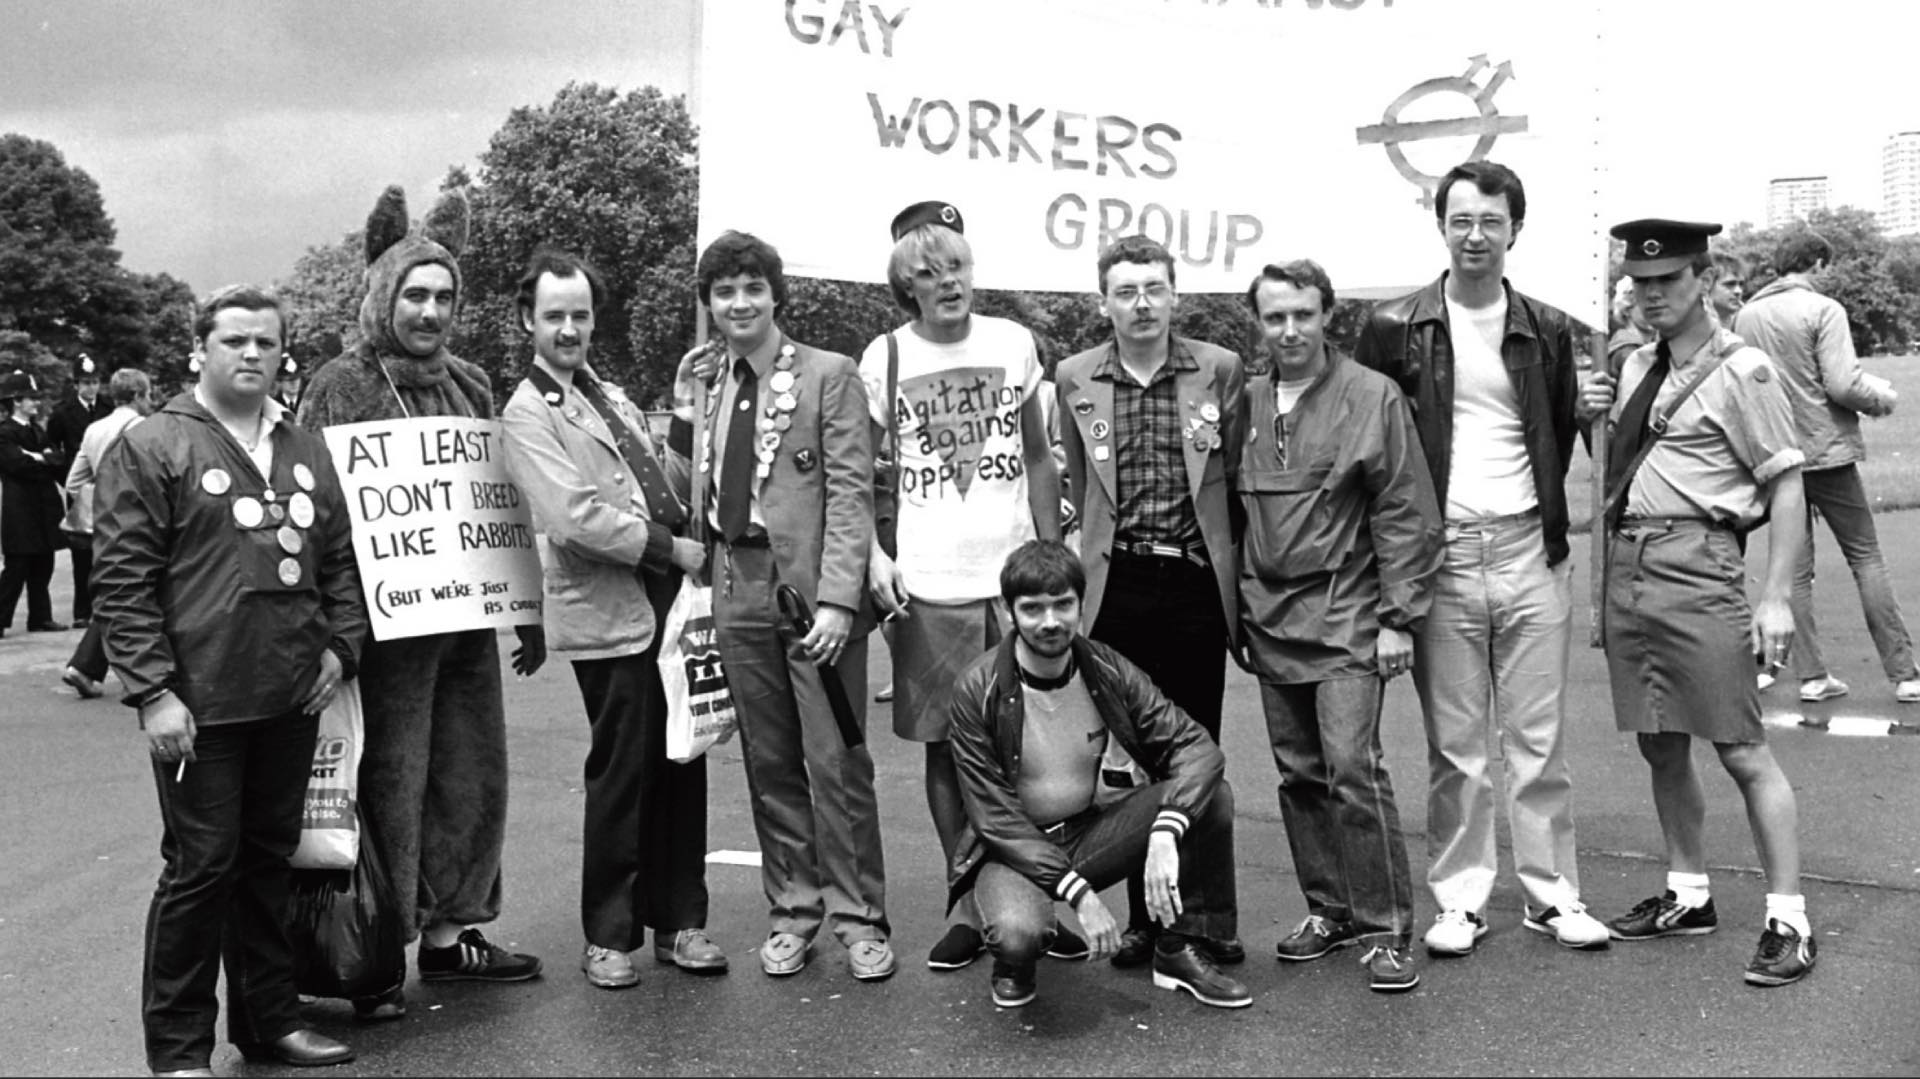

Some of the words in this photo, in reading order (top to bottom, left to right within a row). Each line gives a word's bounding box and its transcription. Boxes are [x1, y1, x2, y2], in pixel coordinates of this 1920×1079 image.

[785, 0, 909, 57] GAY
[867, 92, 1182, 179] WORKERS
[1046, 193, 1263, 272] GROUP
[347, 431, 391, 475] AT
[420, 429, 491, 465] LEAST
[916, 406, 1021, 464] against
[359, 478, 452, 522] DON'T
[470, 481, 519, 510] BREED
[371, 527, 436, 560] LIKE
[458, 521, 532, 551] RABBITS
[375, 580, 422, 619] (BUT
[484, 601, 504, 615] AS
